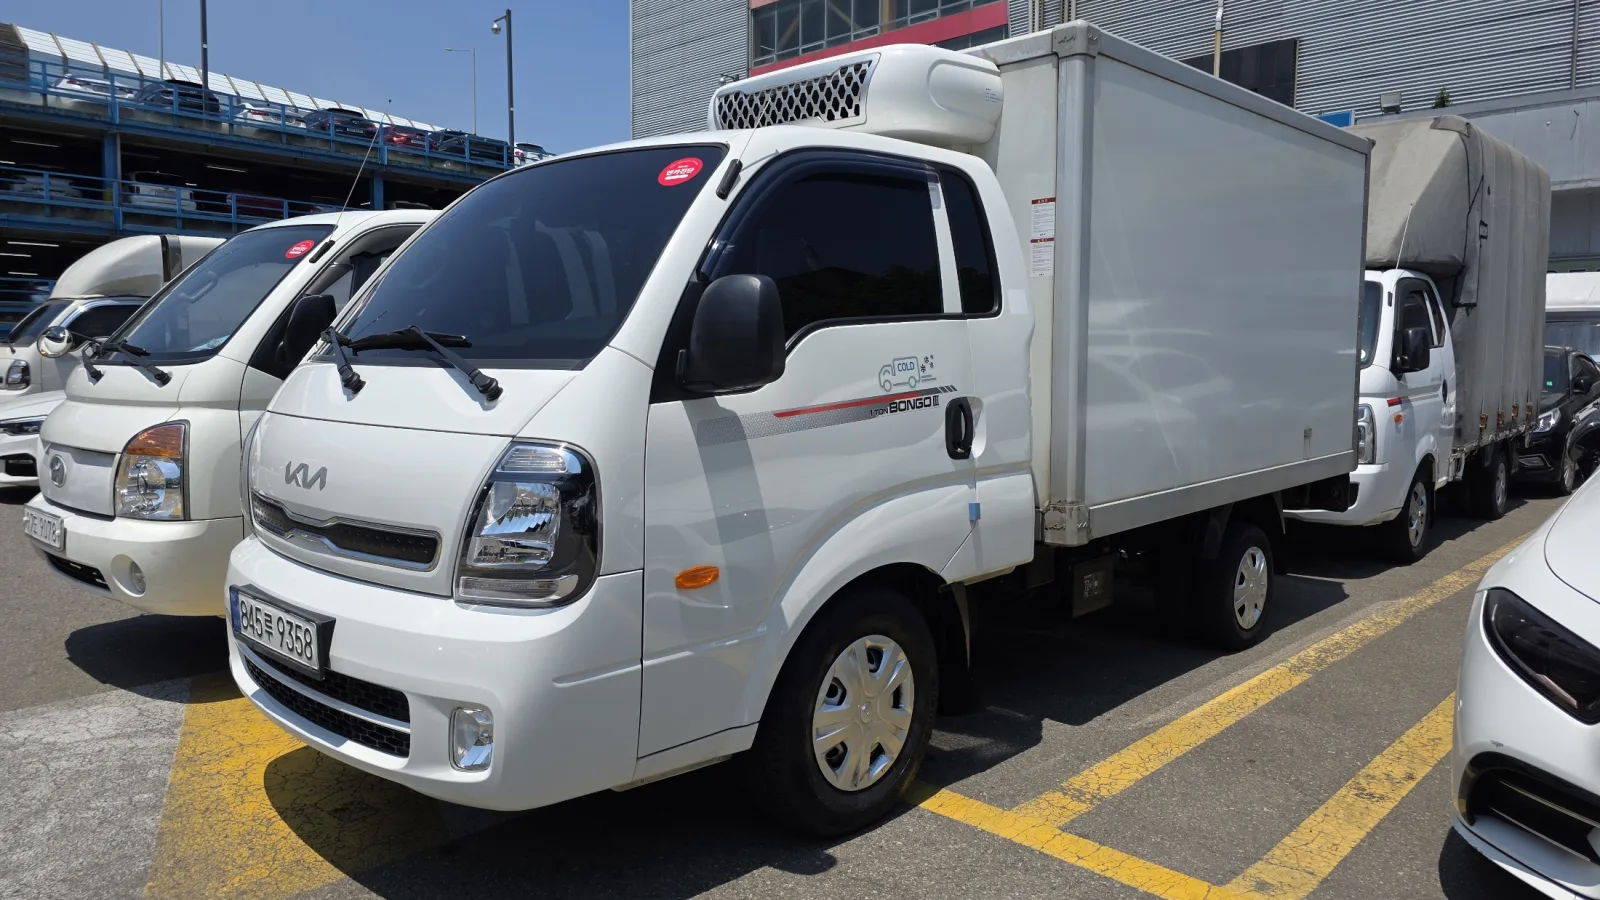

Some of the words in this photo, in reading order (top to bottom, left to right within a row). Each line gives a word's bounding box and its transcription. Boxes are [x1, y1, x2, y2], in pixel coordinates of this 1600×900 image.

[897, 361, 915, 372] COLD
[889, 395, 932, 413] BONGO
[284, 460, 328, 491] KIA
[240, 599, 273, 642] 845루
[277, 615, 313, 661] 9358
